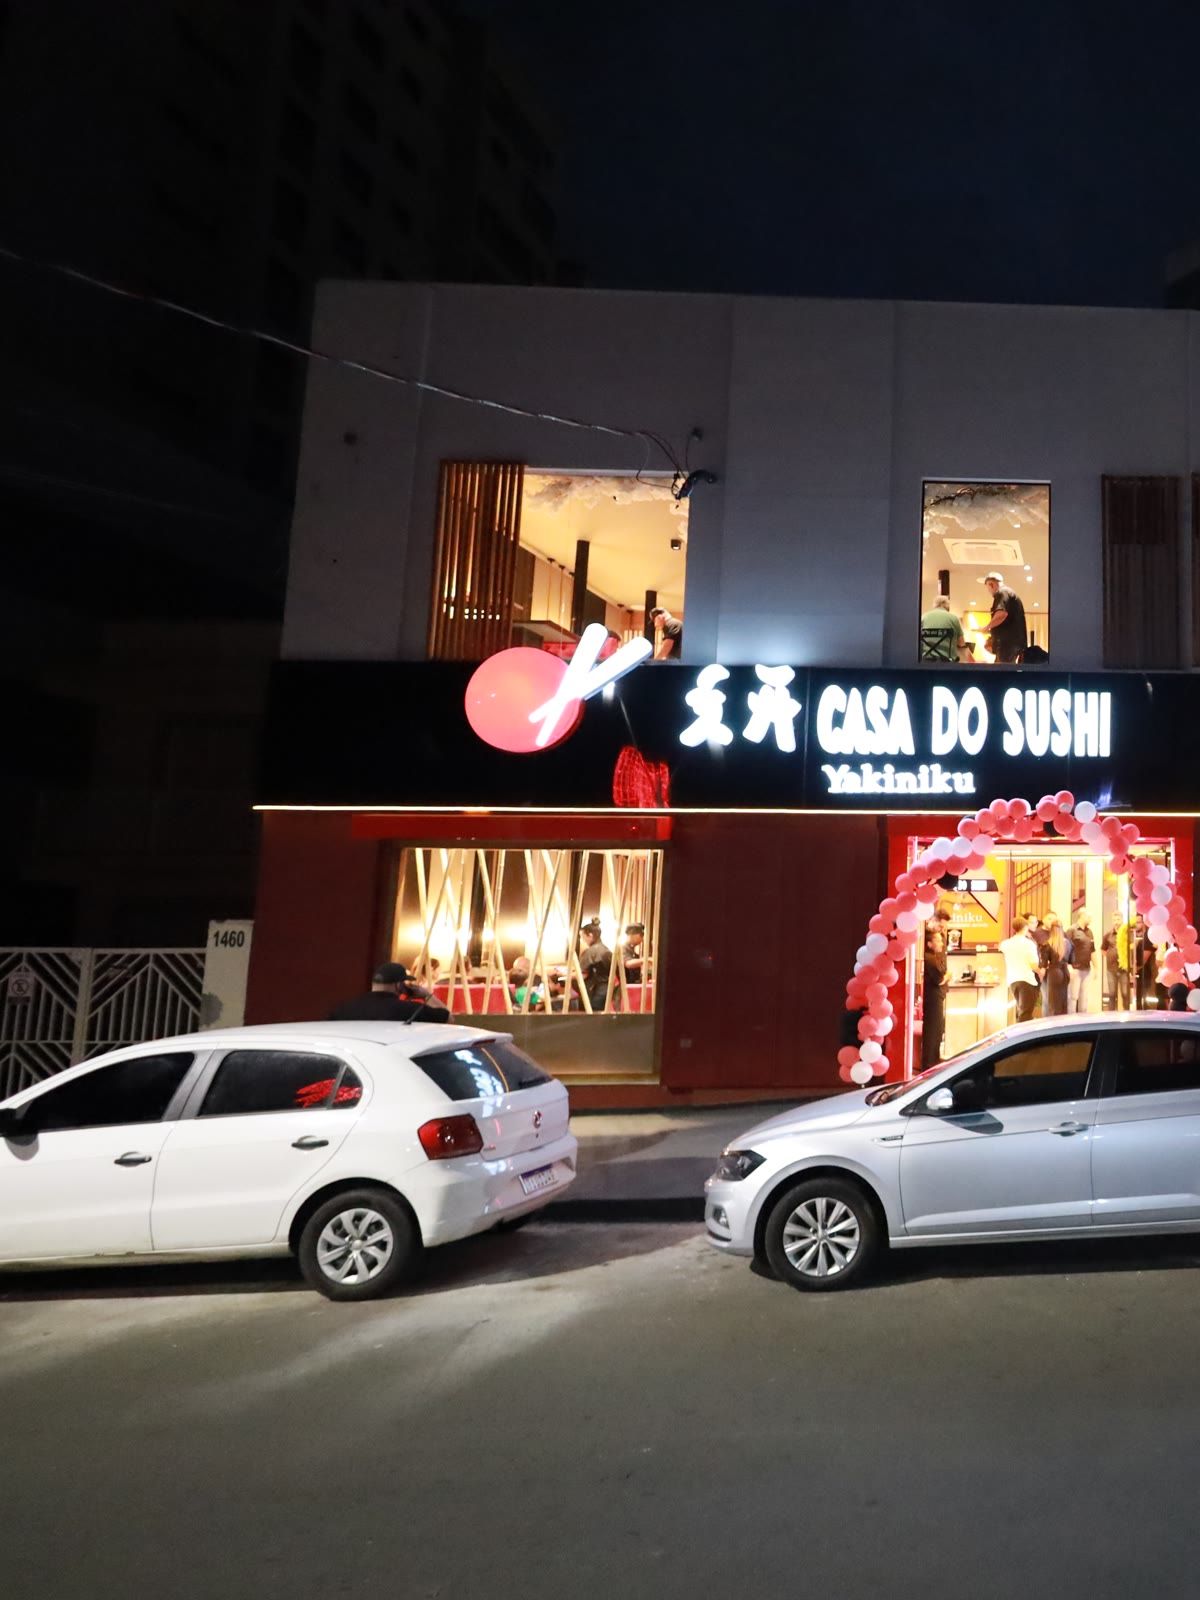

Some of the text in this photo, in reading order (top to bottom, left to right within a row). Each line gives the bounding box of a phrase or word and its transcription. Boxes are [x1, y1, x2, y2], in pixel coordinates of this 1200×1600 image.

[817, 685, 915, 755] CASA
[932, 686, 988, 755] DO
[1003, 687, 1111, 757] SUSHI
[821, 763, 976, 794] Yakiniku
[213, 931, 245, 948] 1460
